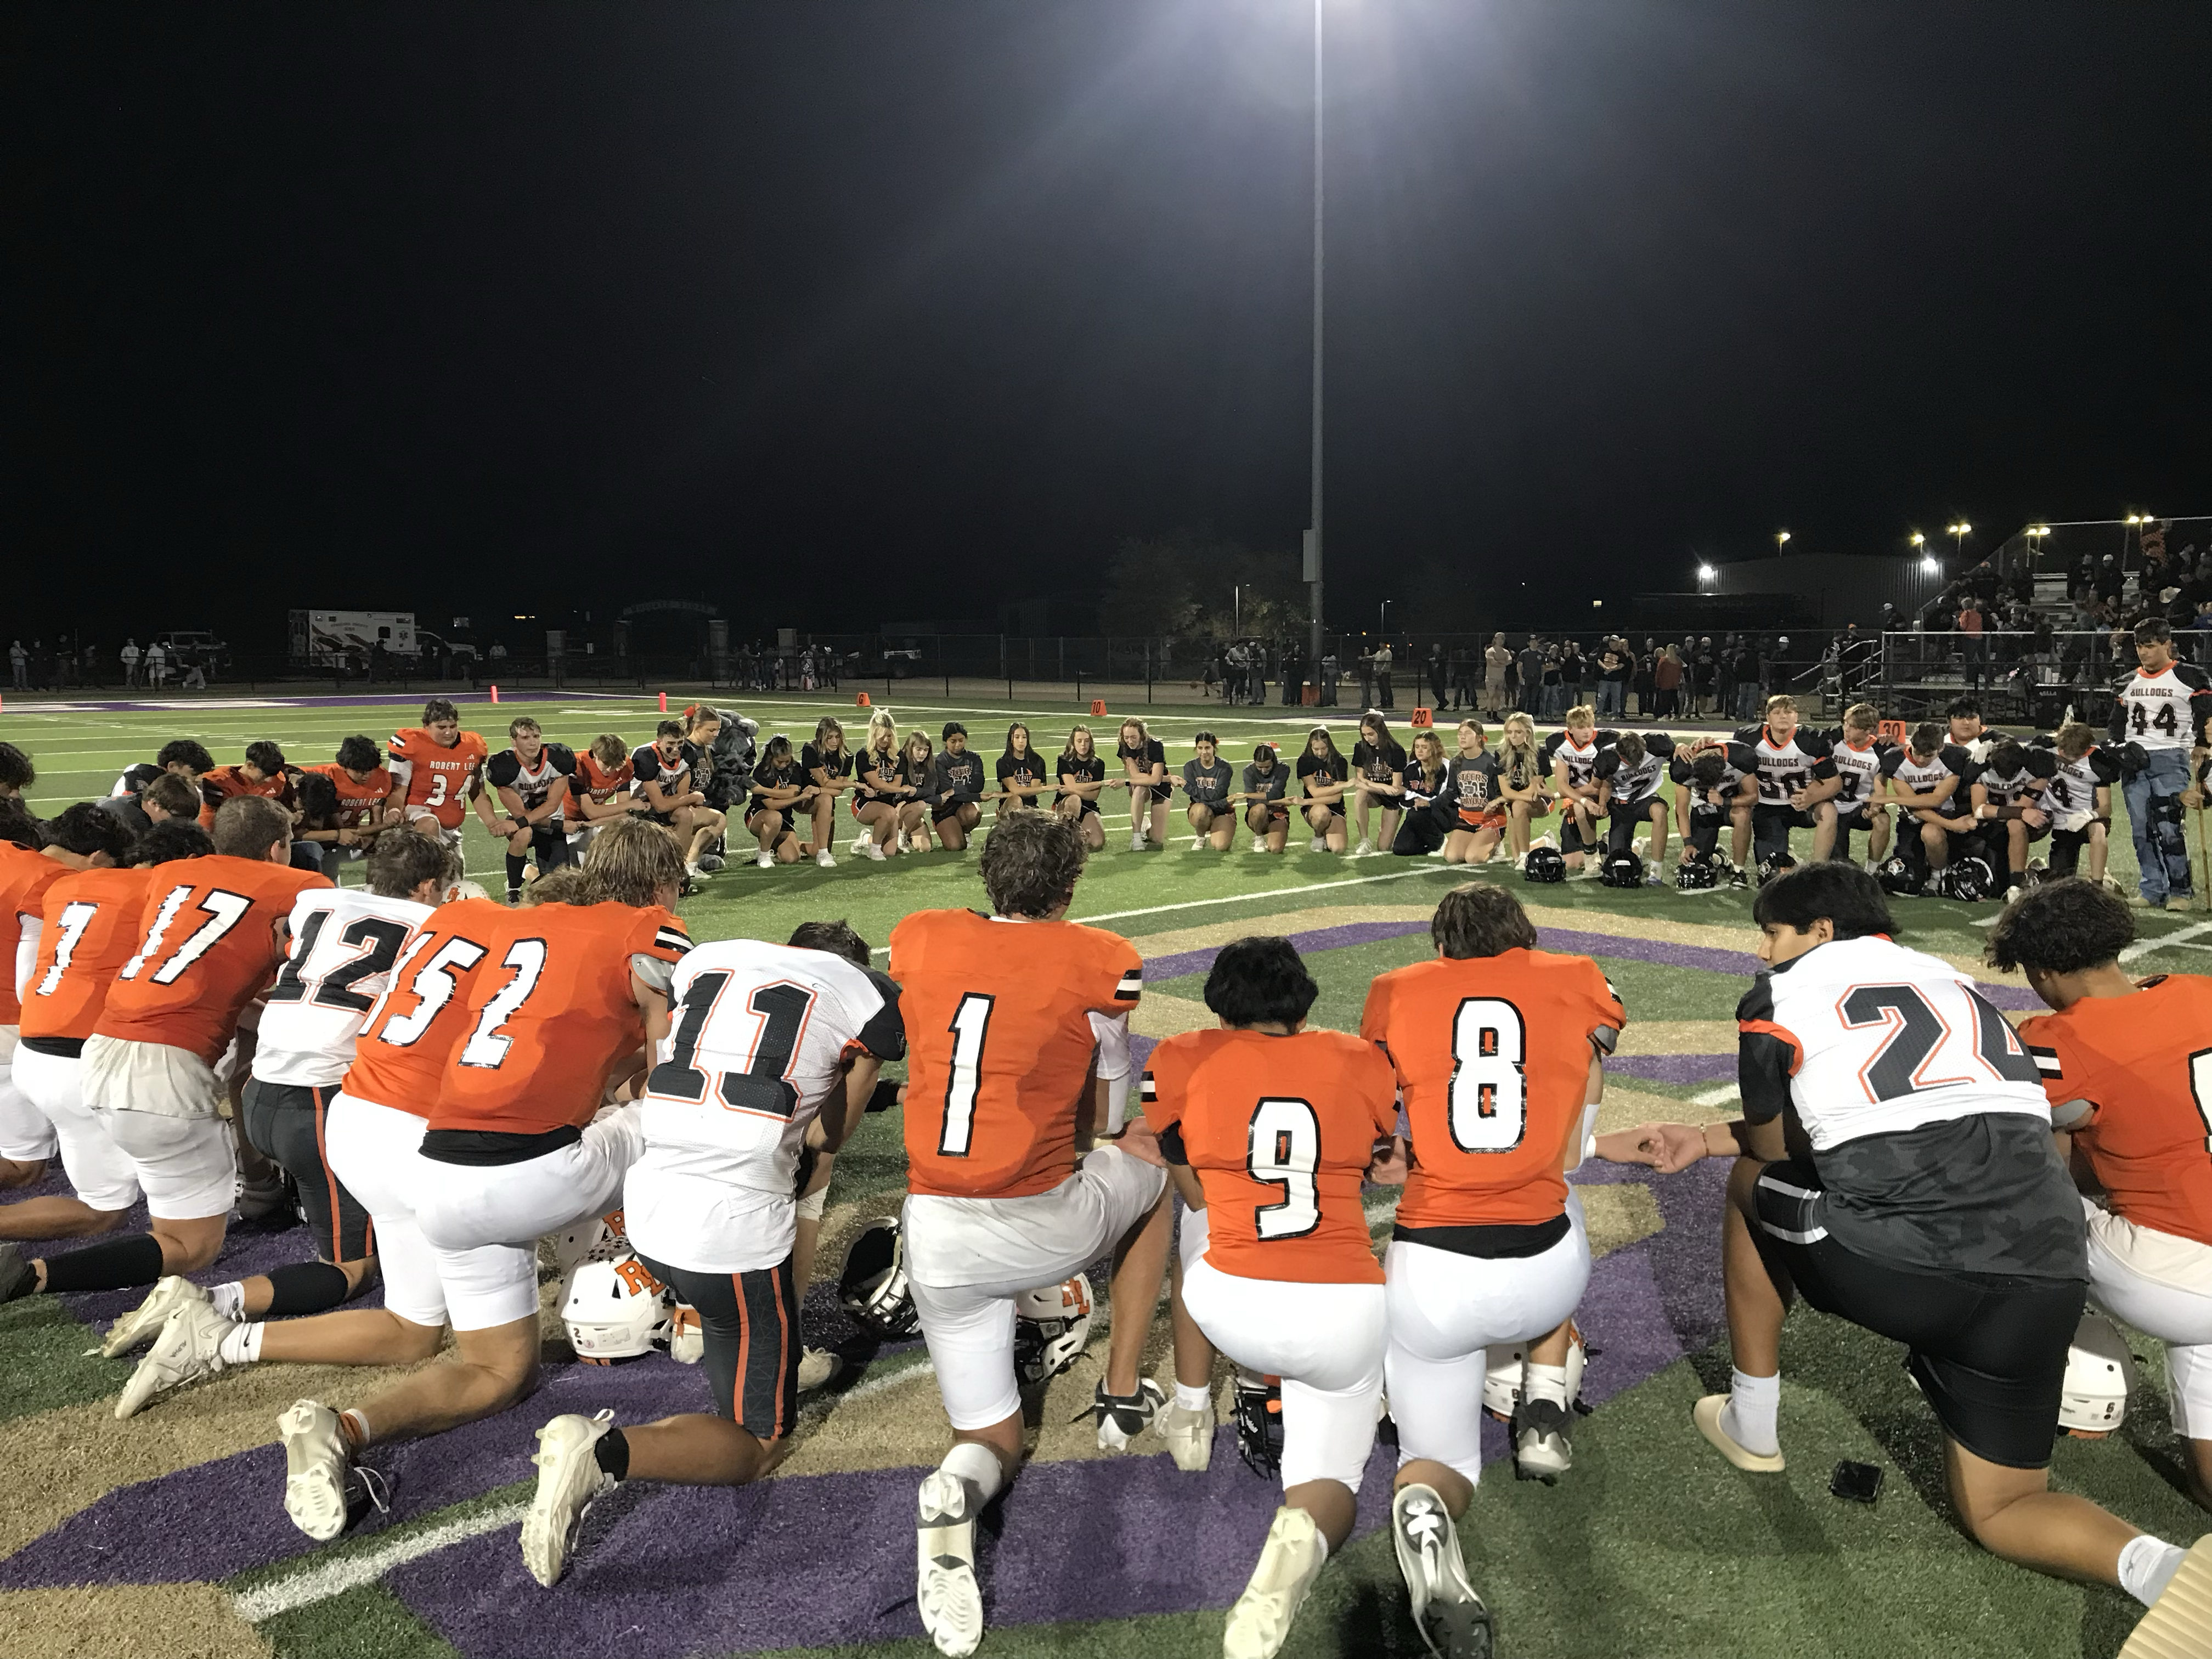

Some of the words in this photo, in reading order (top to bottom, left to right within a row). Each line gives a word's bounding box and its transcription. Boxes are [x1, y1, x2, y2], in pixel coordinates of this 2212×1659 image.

[859, 693, 864, 704] G
[2130, 688, 2173, 697] BULLDOGS
[1092, 701, 1101, 714] 10
[1414, 710, 1427, 725] 20
[2131, 702, 2179, 737] 44
[430, 760, 460, 771] ROBERT
[1562, 754, 1593, 765] BULLDOG
[1757, 757, 1799, 767] BULLDOGS
[1834, 754, 1872, 771] BULLDOGS
[1457, 774, 1488, 783] STEERS
[1620, 764, 1656, 781] BULLDOGS
[425, 774, 474, 809] 34
[1630, 777, 1651, 802] 7
[1835, 770, 1861, 803] 9
[341, 798, 367, 806] ROBERT
[117, 885, 257, 986] 17
[36, 901, 100, 996] 1
[267, 908, 414, 1016] 12
[357, 930, 491, 1048] 15
[457, 936, 549, 1071] 2
[646, 968, 819, 1124] 11
[936, 991, 997, 1158] 1
[1447, 995, 1528, 1155] 8
[1247, 1096, 1323, 1242] 9
[573, 1327, 581, 1339] 2
[2106, 1401, 2116, 1414] 6
